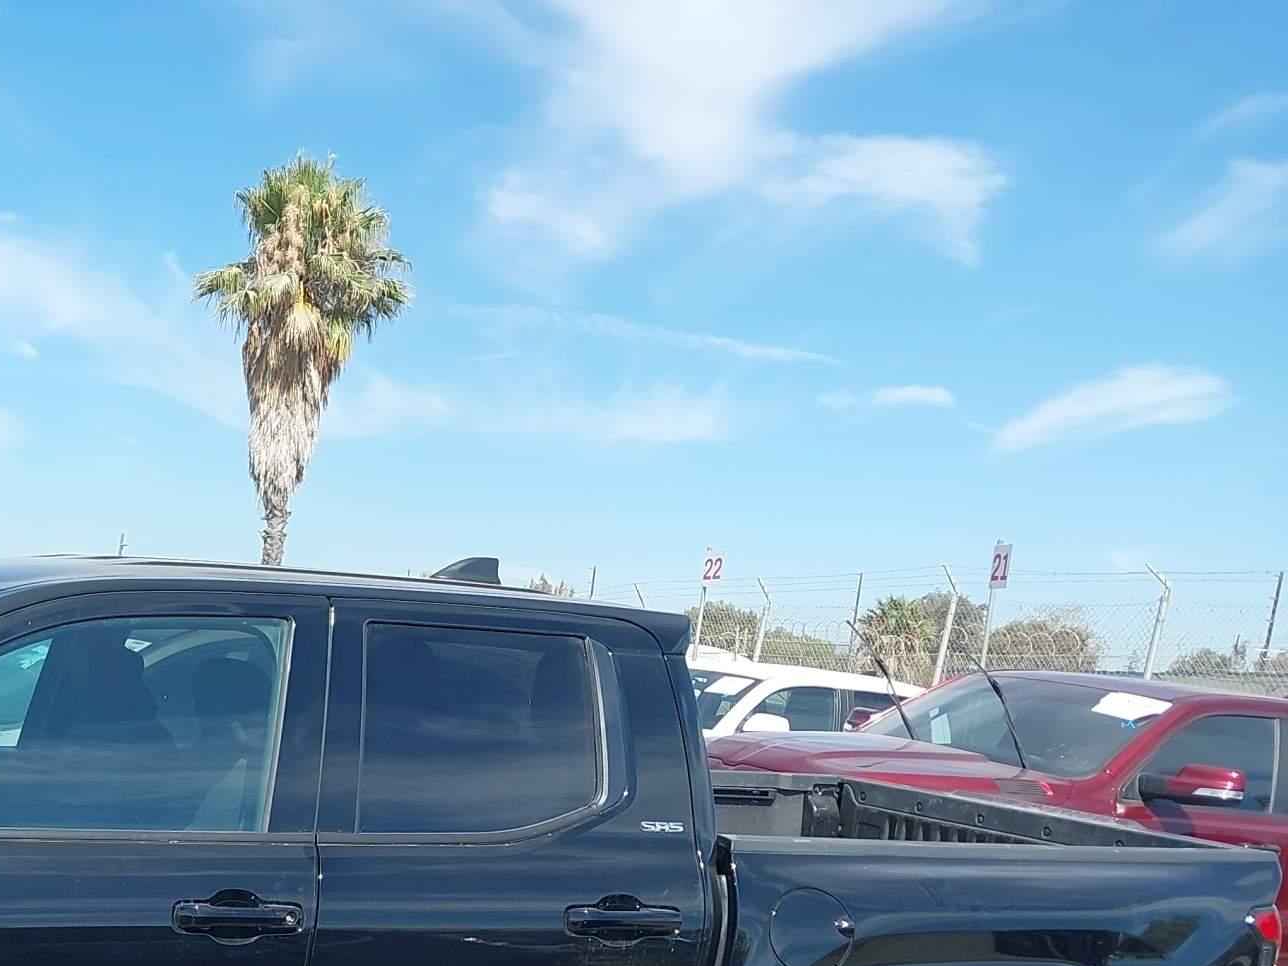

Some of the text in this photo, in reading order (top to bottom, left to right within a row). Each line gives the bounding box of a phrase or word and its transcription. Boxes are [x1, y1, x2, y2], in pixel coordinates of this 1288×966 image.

[703, 557, 723, 580] 22
[991, 553, 1009, 581] 21
[641, 821, 684, 833] SR5
